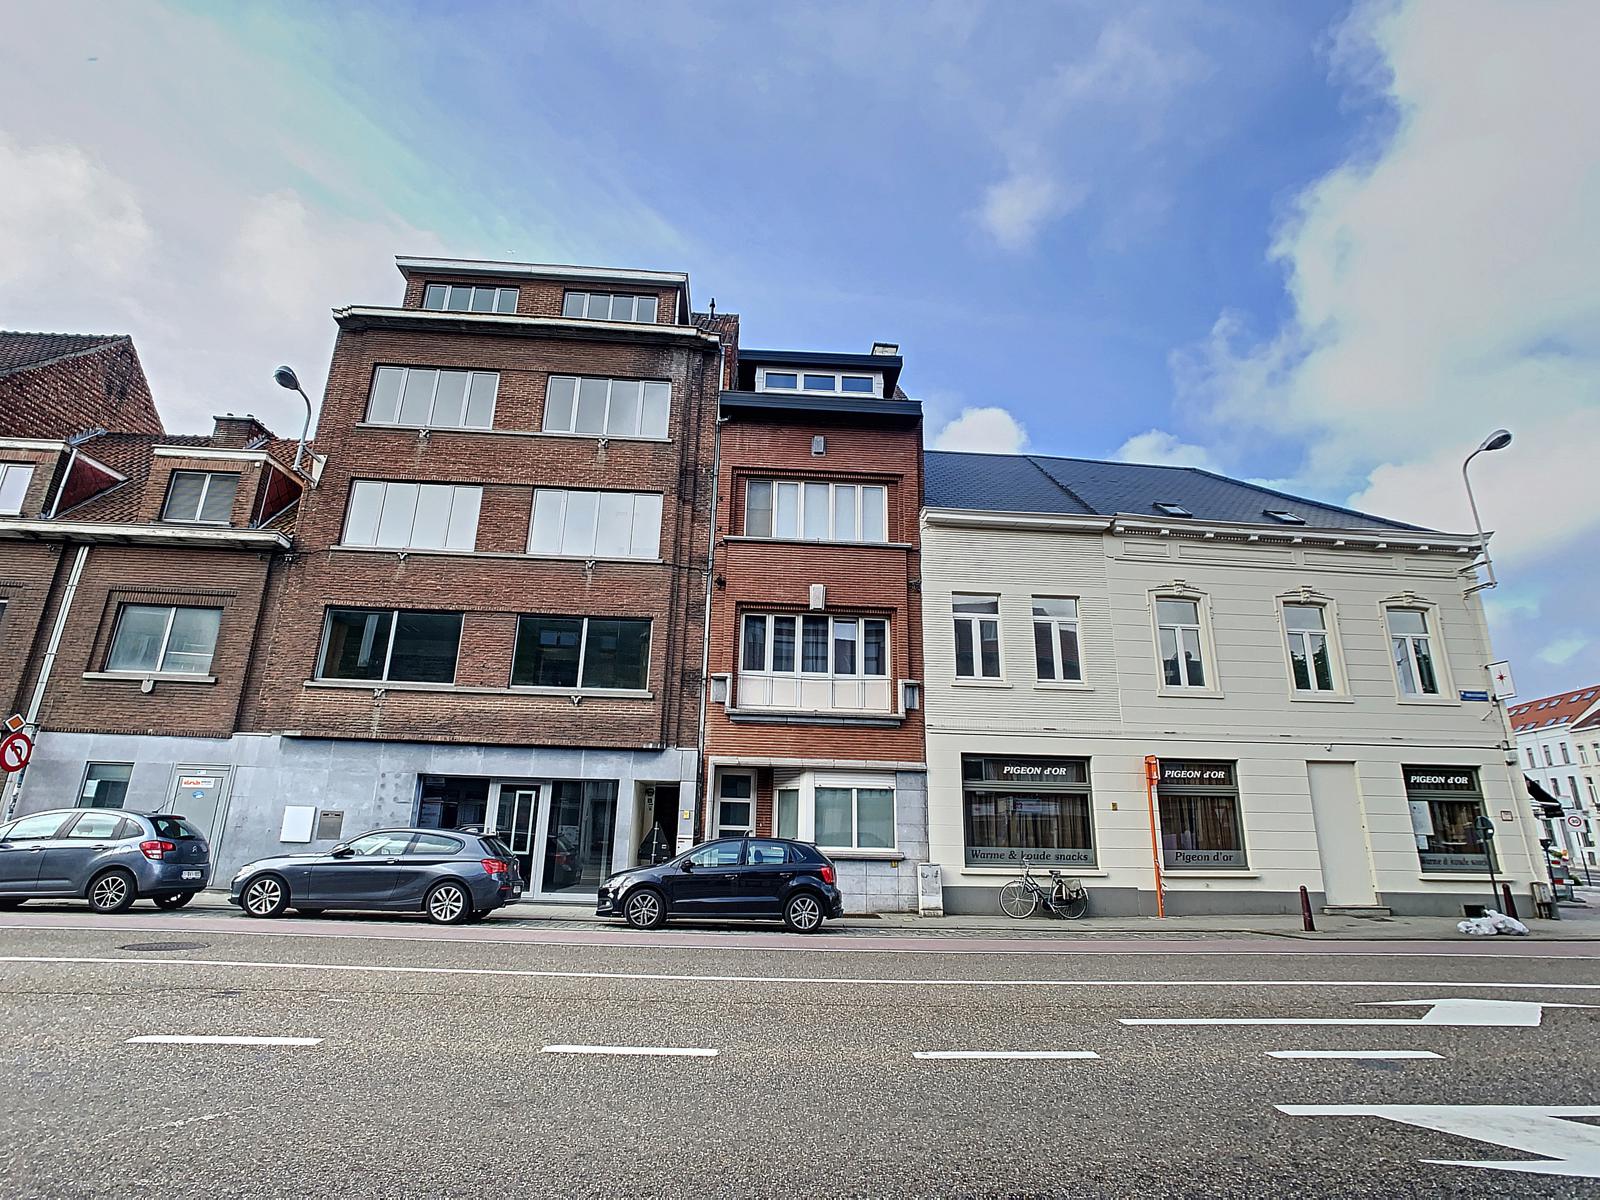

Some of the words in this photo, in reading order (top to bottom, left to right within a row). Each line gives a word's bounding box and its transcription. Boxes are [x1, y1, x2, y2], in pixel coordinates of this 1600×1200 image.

[1003, 766, 1042, 775] PIGEON
[1043, 767, 1067, 775] d'OR
[1164, 770, 1202, 778] PIGEON
[1410, 775, 1446, 784] PIGEON
[971, 849, 1005, 859] Warme
[1008, 850, 1017, 859] &
[1021, 850, 1053, 860] koude
[1055, 852, 1088, 861] snacks
[1175, 851, 1210, 863] Pigeon
[1212, 851, 1234, 862] d'or
